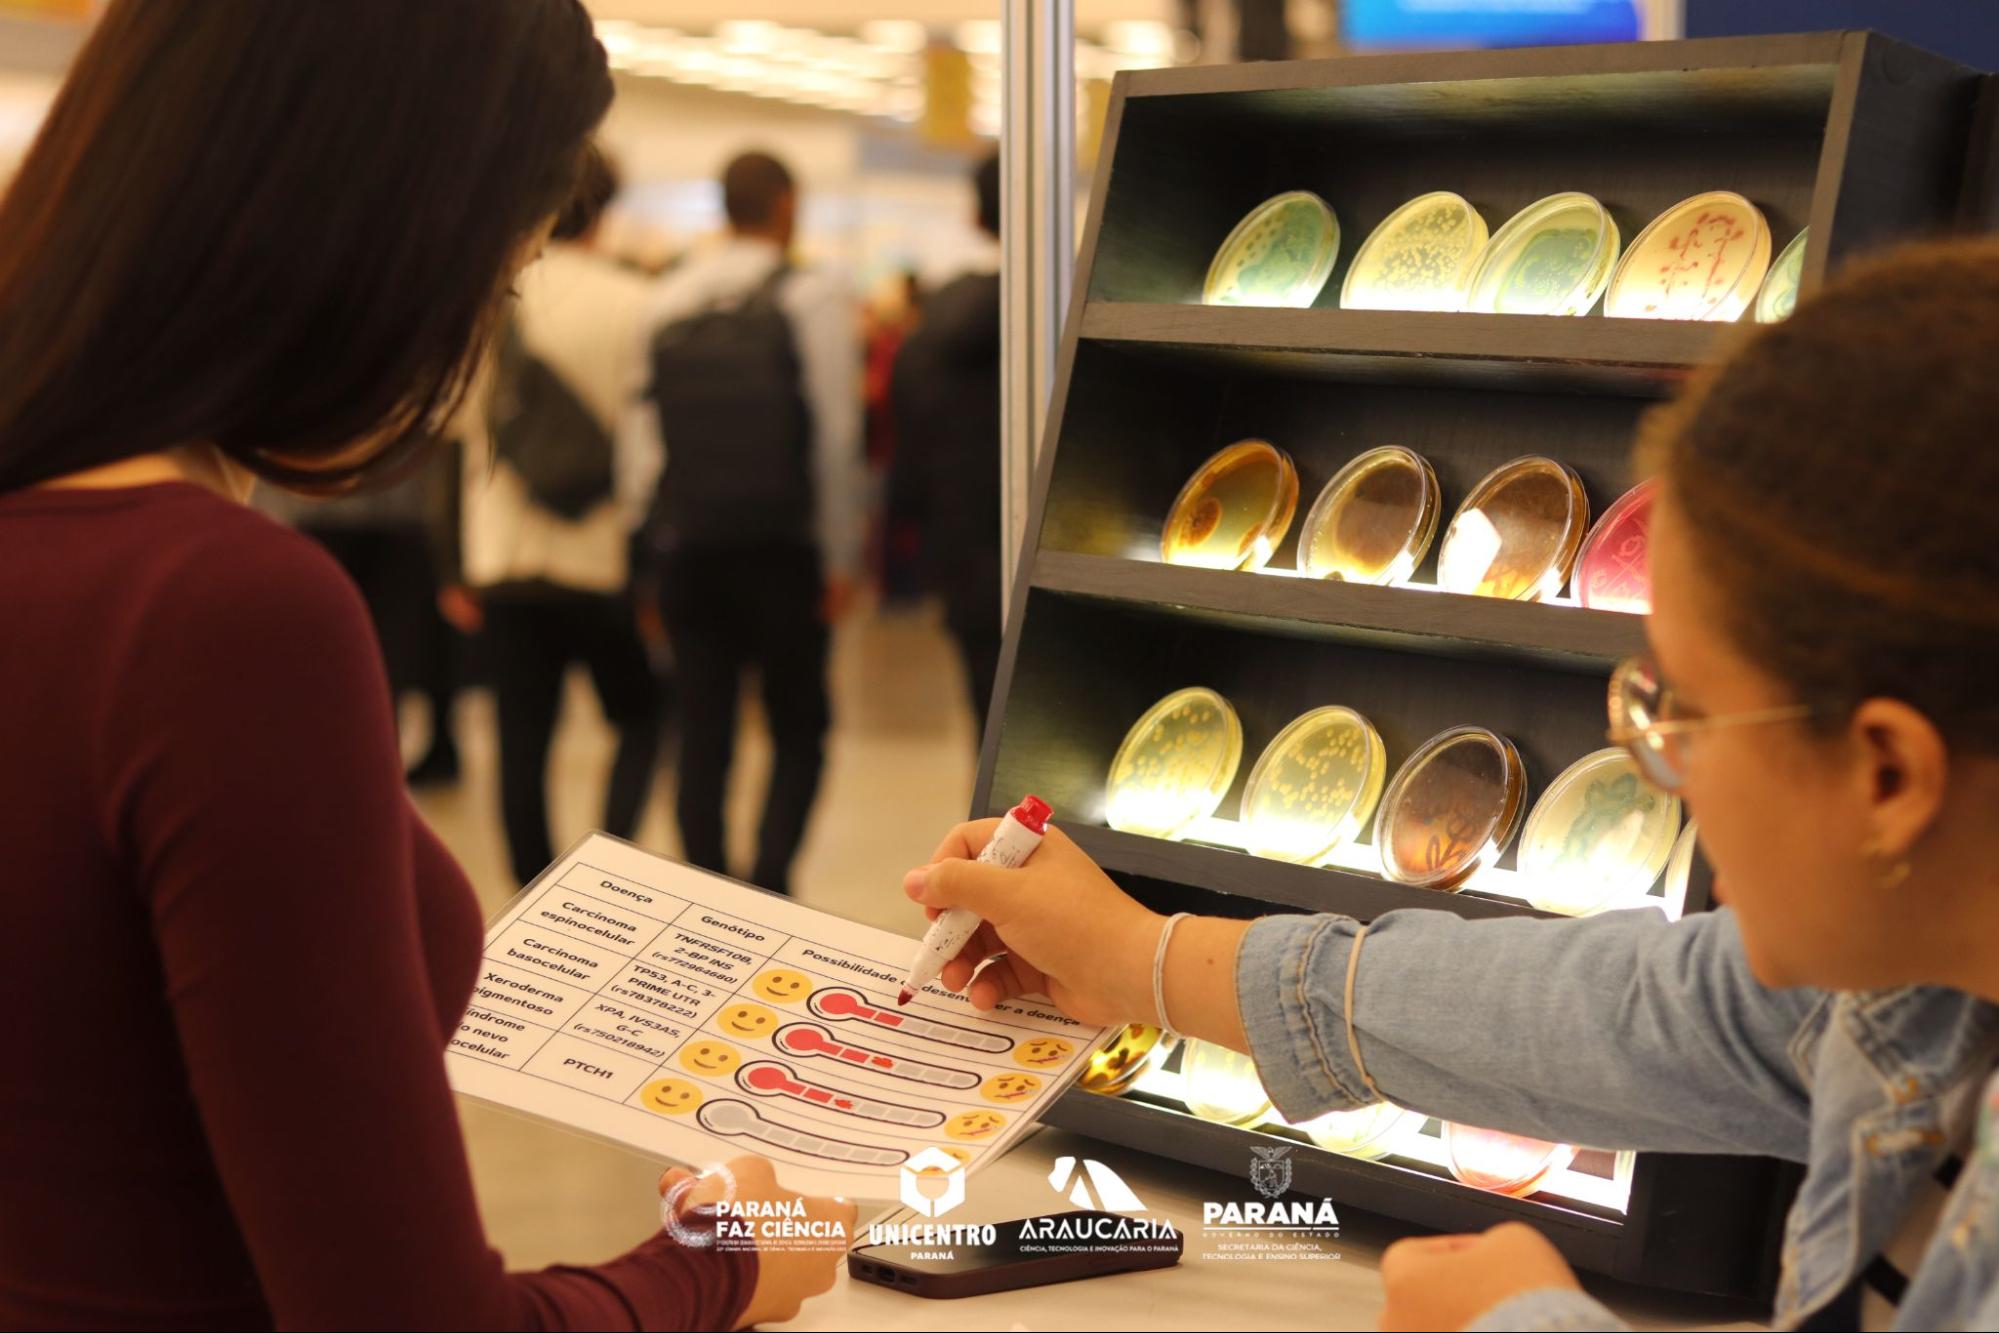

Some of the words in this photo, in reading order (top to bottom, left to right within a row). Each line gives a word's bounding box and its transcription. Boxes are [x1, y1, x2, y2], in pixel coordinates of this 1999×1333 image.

[599, 880, 653, 903] Doença
[541, 910, 635, 947] espinocelular
[562, 902, 636, 932] Carcinoma
[701, 915, 765, 942] Genótipo
[523, 938, 598, 968] Carcinoma
[674, 933, 752, 964] TNFRSF10B,
[674, 947, 710, 964] 2-BP
[709, 957, 734, 970] INS
[507, 948, 590, 981] basocelular
[802, 948, 898, 985] Possibilidade
[484, 972, 564, 1002] Xeroderma
[628, 977, 670, 996] PRIME
[673, 993, 701, 1006] UTR
[634, 965, 668, 983] TP53,
[671, 979, 699, 994] A-C,
[466, 1008, 526, 1032] índrome
[596, 1004, 626, 1018] XPA,
[472, 1028, 508, 1042] nevo
[616, 1025, 644, 1037] G-C
[563, 1057, 613, 1080] PTCH1
